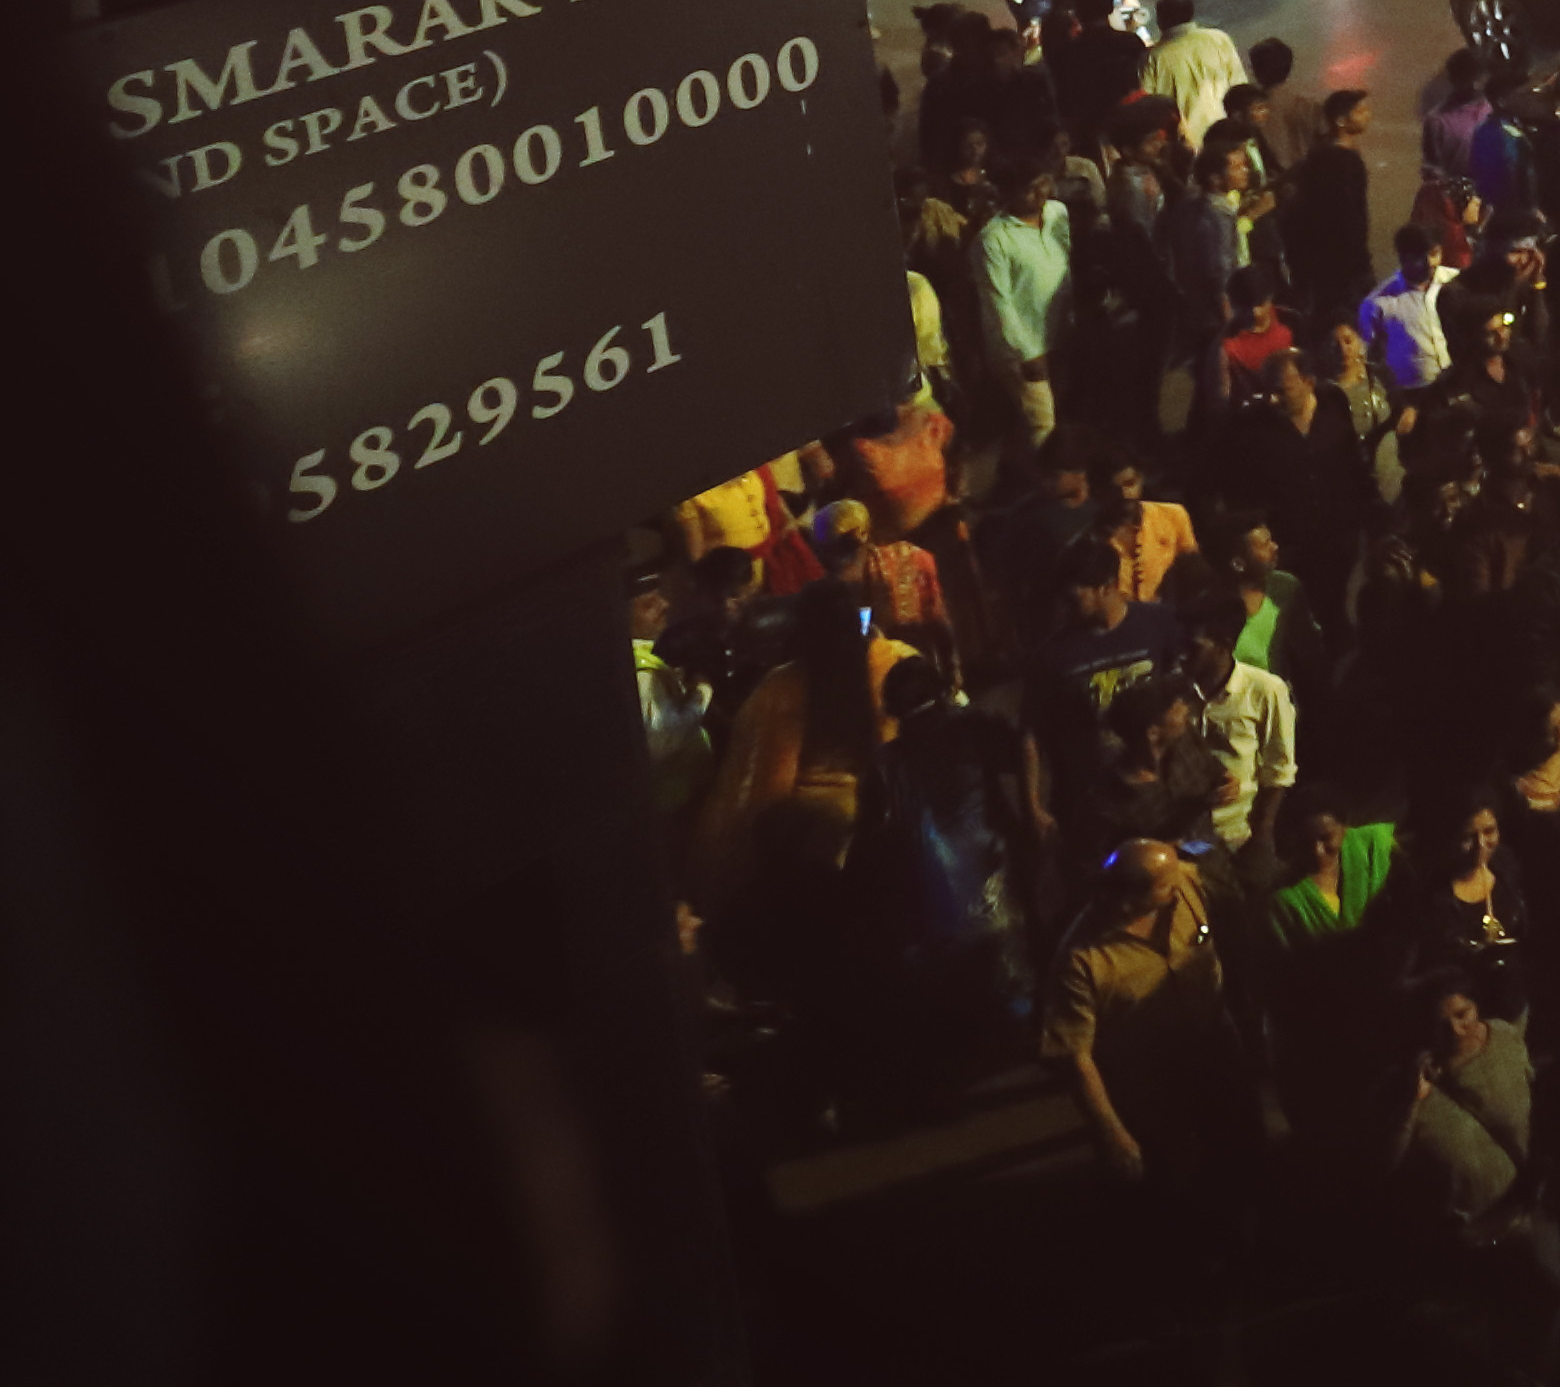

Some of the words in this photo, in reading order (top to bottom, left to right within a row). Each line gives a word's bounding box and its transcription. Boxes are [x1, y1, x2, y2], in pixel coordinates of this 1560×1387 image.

[155, 36, 820, 311] 04580010000
[263, 49, 509, 169] SPACE)
[288, 311, 682, 524] 5829561
